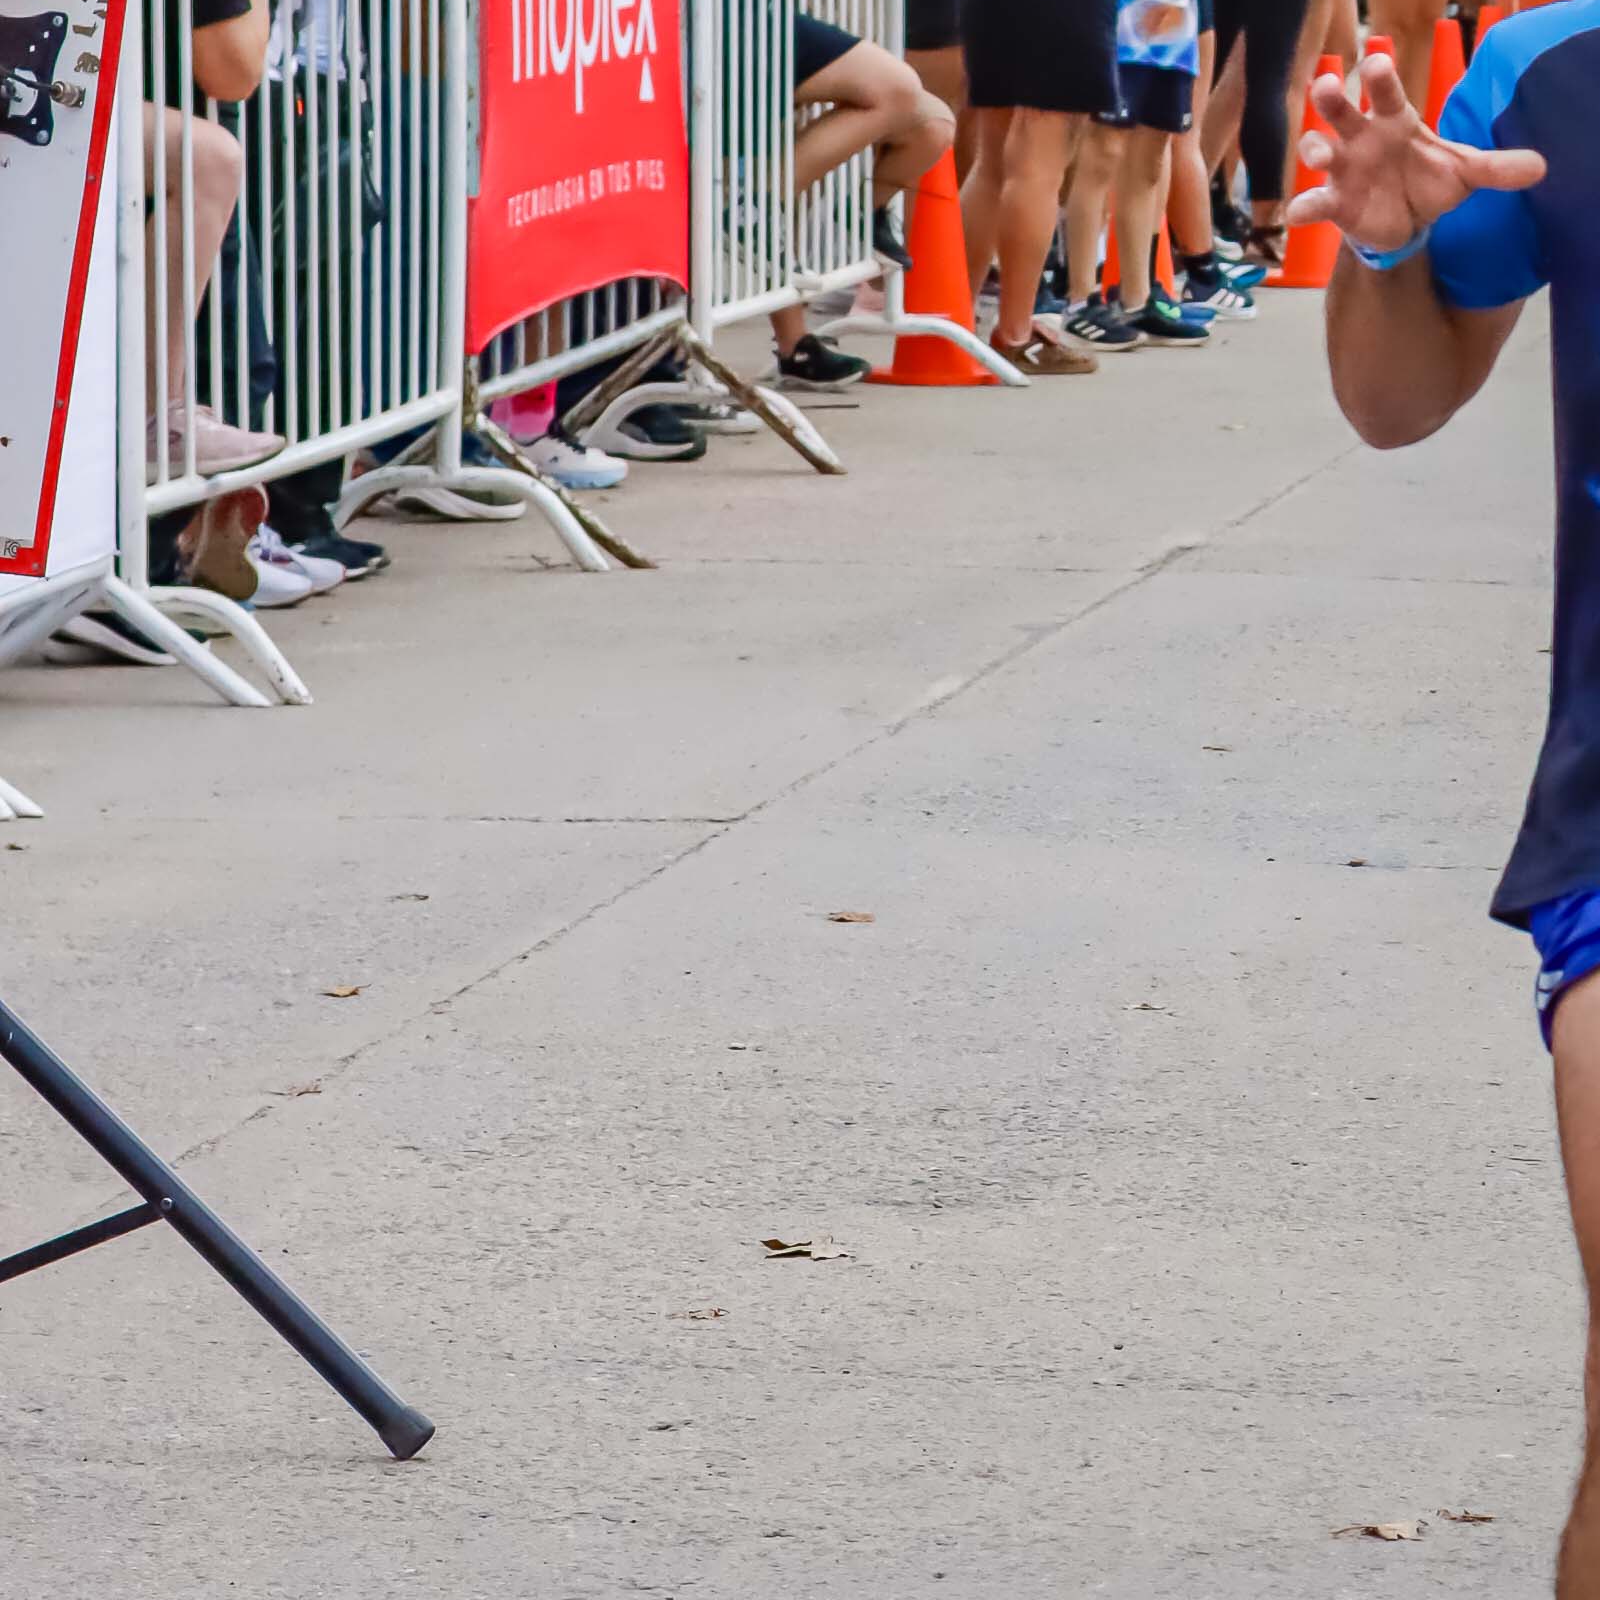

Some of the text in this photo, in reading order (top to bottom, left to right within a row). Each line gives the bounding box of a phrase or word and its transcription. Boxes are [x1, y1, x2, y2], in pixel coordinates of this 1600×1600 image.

[589, 168, 604, 201] EN
[608, 161, 631, 194] TUS
[636, 159, 665, 191] PIES
